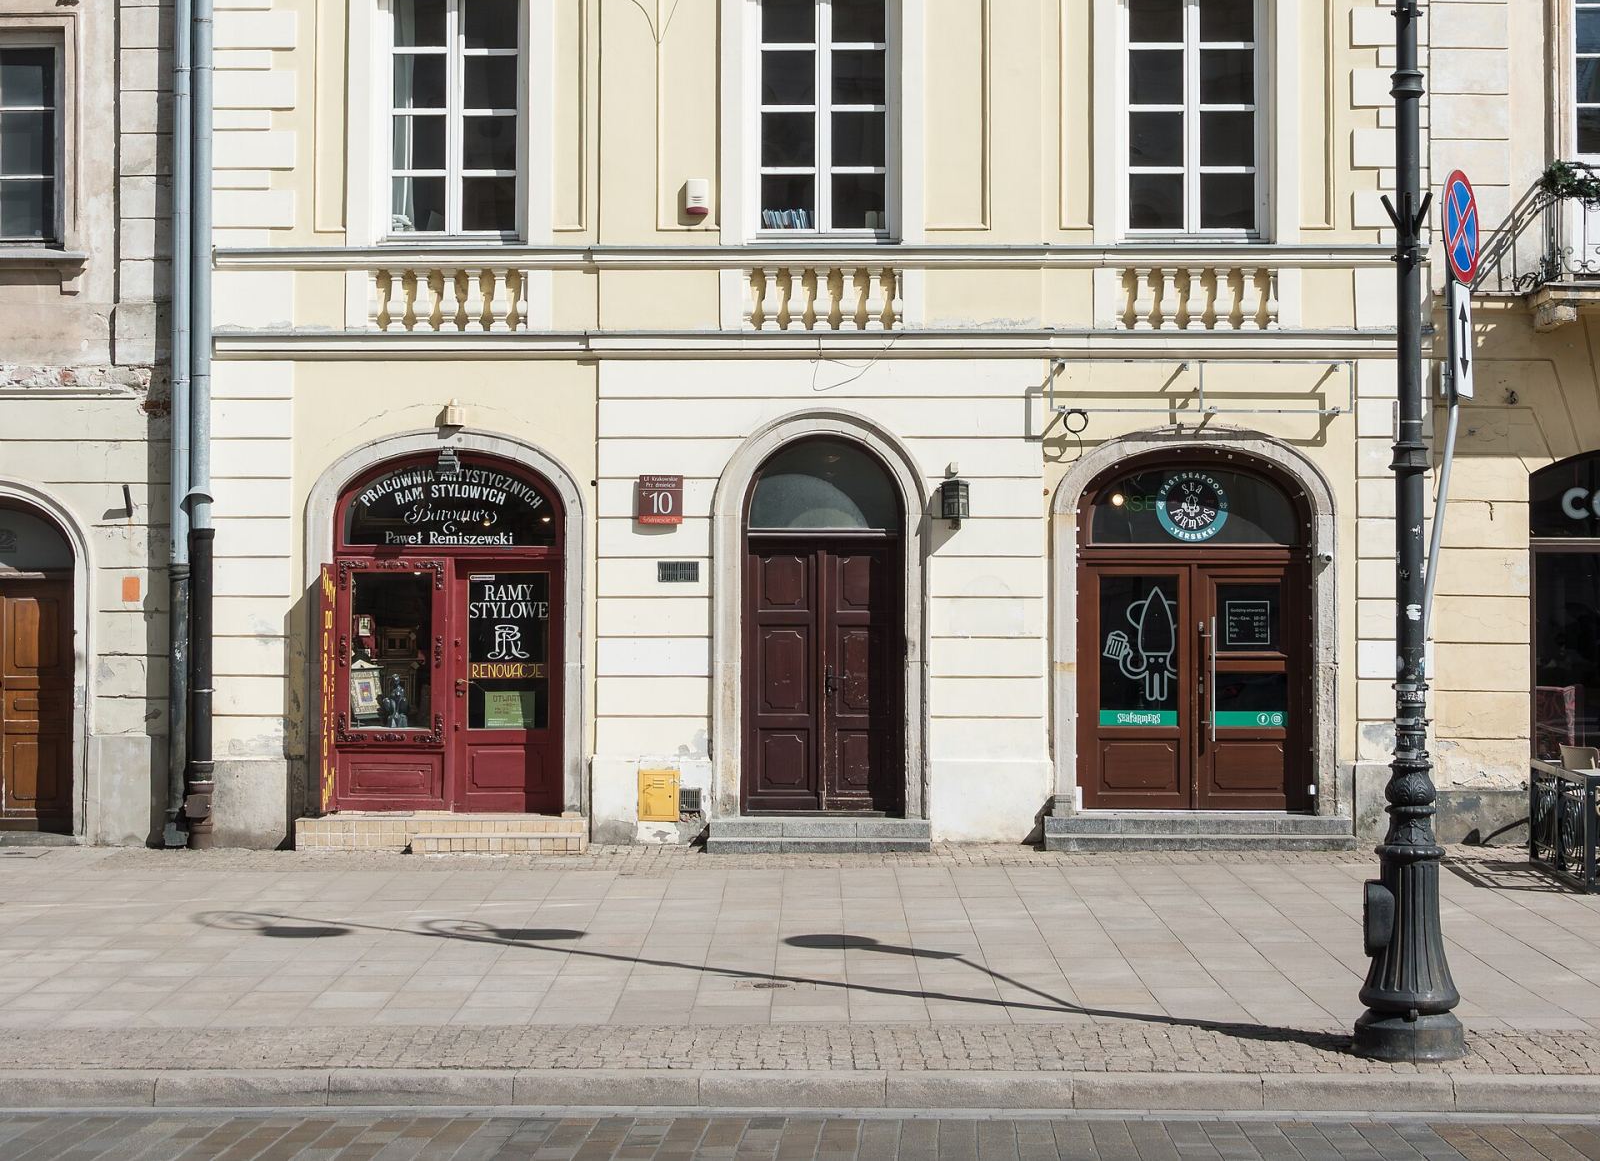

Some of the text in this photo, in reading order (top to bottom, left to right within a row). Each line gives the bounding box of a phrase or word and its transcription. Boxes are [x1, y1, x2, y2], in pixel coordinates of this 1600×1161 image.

[360, 469, 436, 507] PRACOWNIA
[1160, 471, 1224, 495] FAST SEAFOOD
[394, 484, 507, 506] RAM STYLOWYCH
[649, 491, 673, 514] 10
[1561, 487, 1600, 520] C
[385, 531, 514, 545] Paweł Remiszewski
[1173, 527, 1214, 540] YERSEKE
[322, 567, 336, 608] RAMY
[484, 584, 534, 601] RAMY
[325, 610, 333, 629] DO
[469, 601, 549, 619] STYLOWE
[472, 663, 544, 678] RENOWACJE
